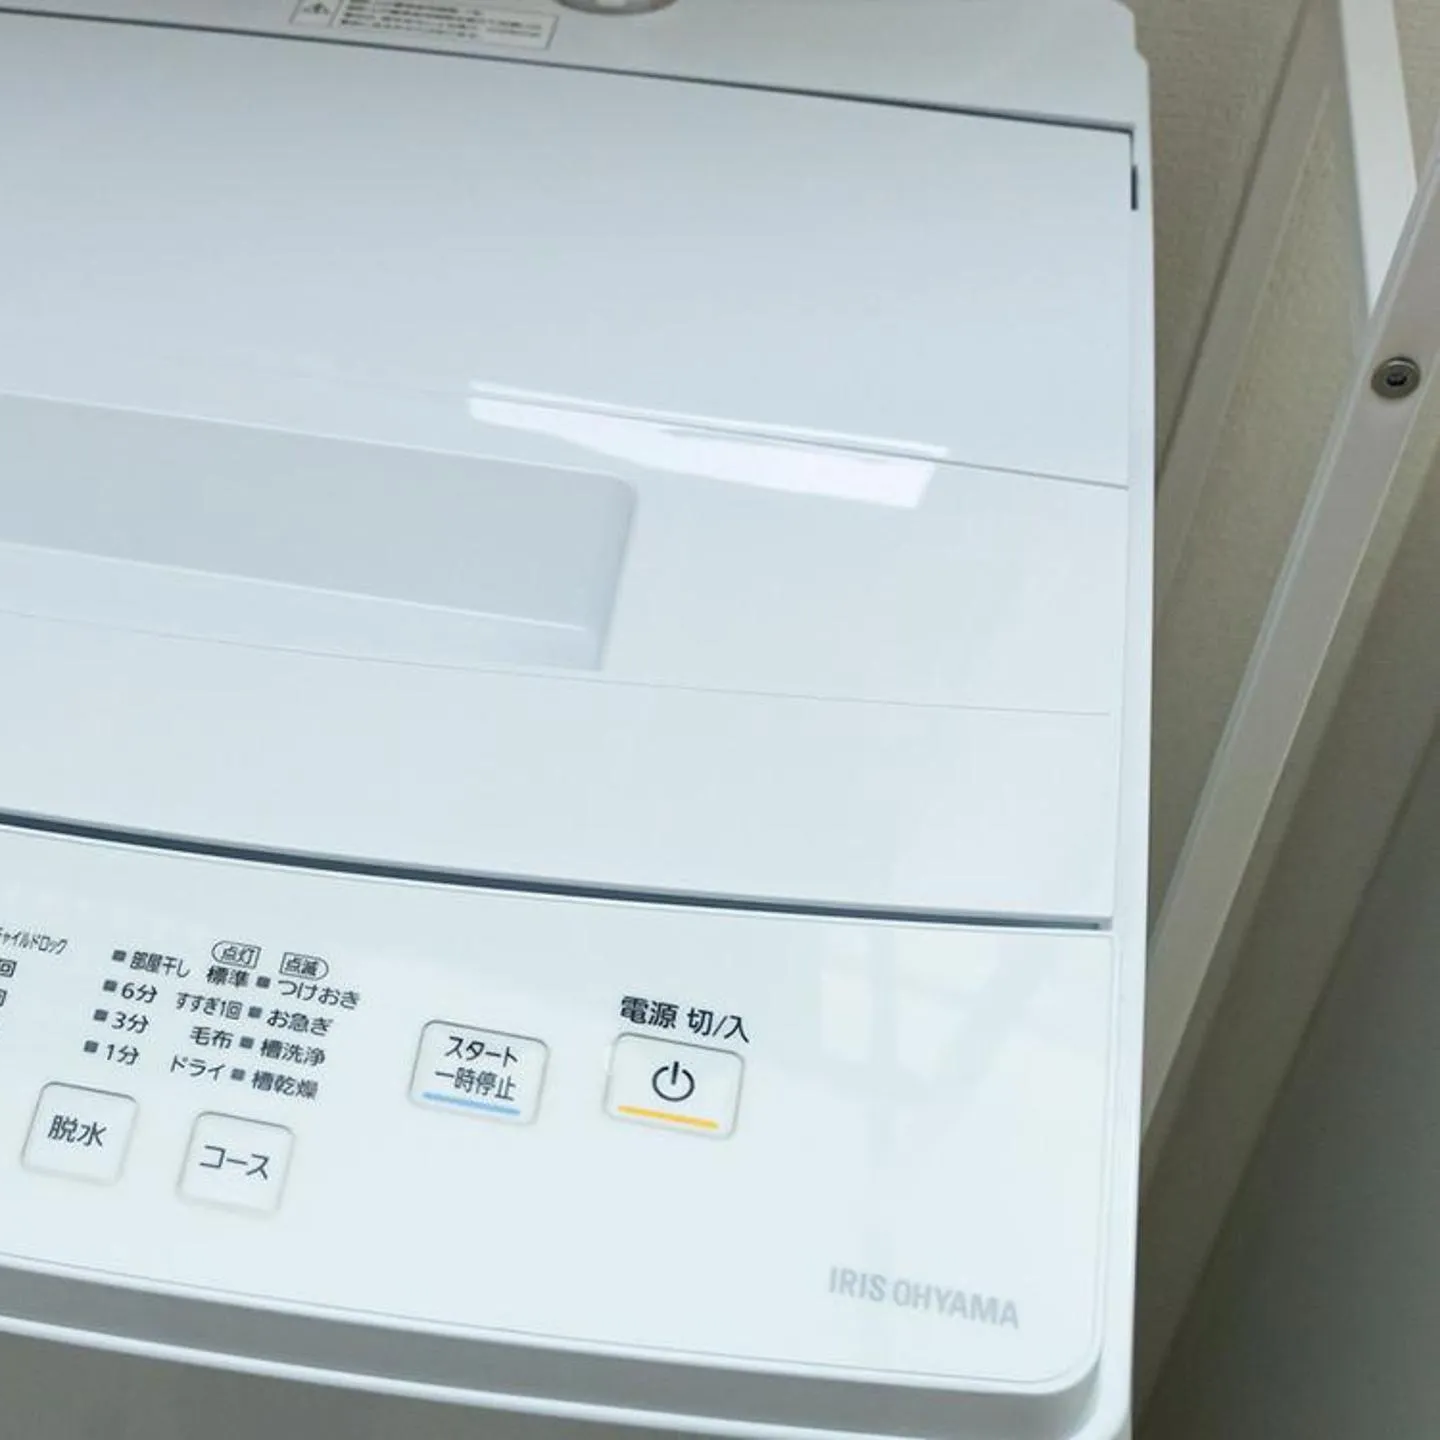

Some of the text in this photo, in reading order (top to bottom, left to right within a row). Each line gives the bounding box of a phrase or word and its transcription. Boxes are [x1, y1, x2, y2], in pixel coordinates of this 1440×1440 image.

[121, 982, 158, 1004] 6分
[278, 979, 361, 1010] つけおき
[111, 1012, 149, 1034] 3分
[176, 992, 334, 1036] すすぎ1回 お急ぎ
[620, 995, 750, 1043] 電源 切/入
[106, 1044, 140, 1066] 1分
[190, 1026, 326, 1067] 毛布 槽洗浄
[444, 1035, 518, 1067] スタート
[169, 1054, 226, 1081] ドライ
[435, 1067, 516, 1101] 一時停止
[48, 1115, 107, 1147] 脱水
[199, 1144, 270, 1180] コース
[828, 1265, 1019, 1329] IRIS OHYAMA
